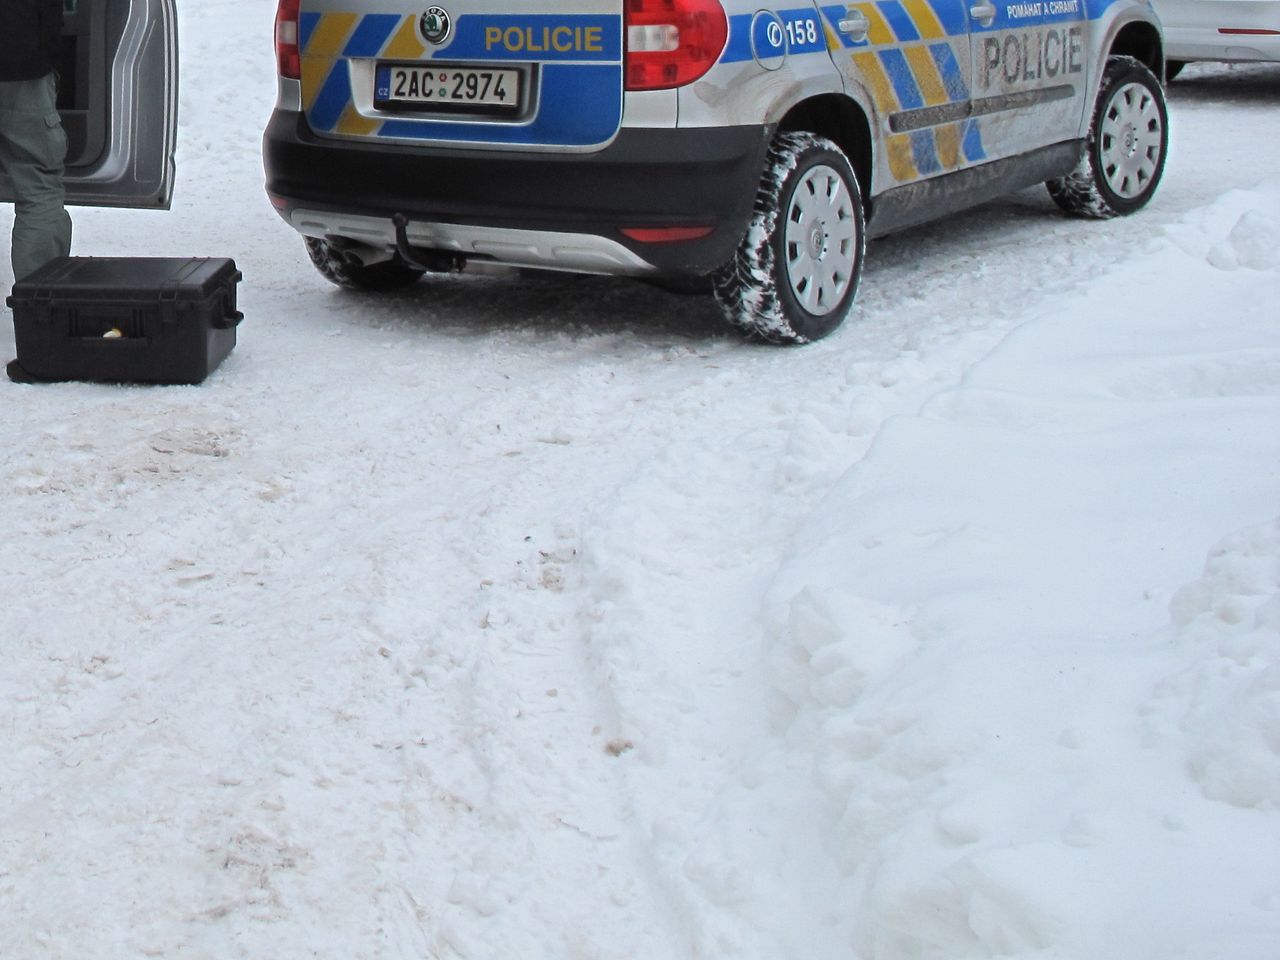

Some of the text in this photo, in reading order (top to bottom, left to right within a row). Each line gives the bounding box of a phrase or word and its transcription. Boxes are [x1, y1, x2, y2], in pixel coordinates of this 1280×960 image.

[1006, 1, 1041, 19] POMÁHAT
[1043, 6, 1050, 16] A
[485, 26, 604, 52] POLICIE
[786, 19, 817, 45] 158
[983, 27, 1082, 88] POLICIE
[394, 71, 507, 101] 2AC 2974
